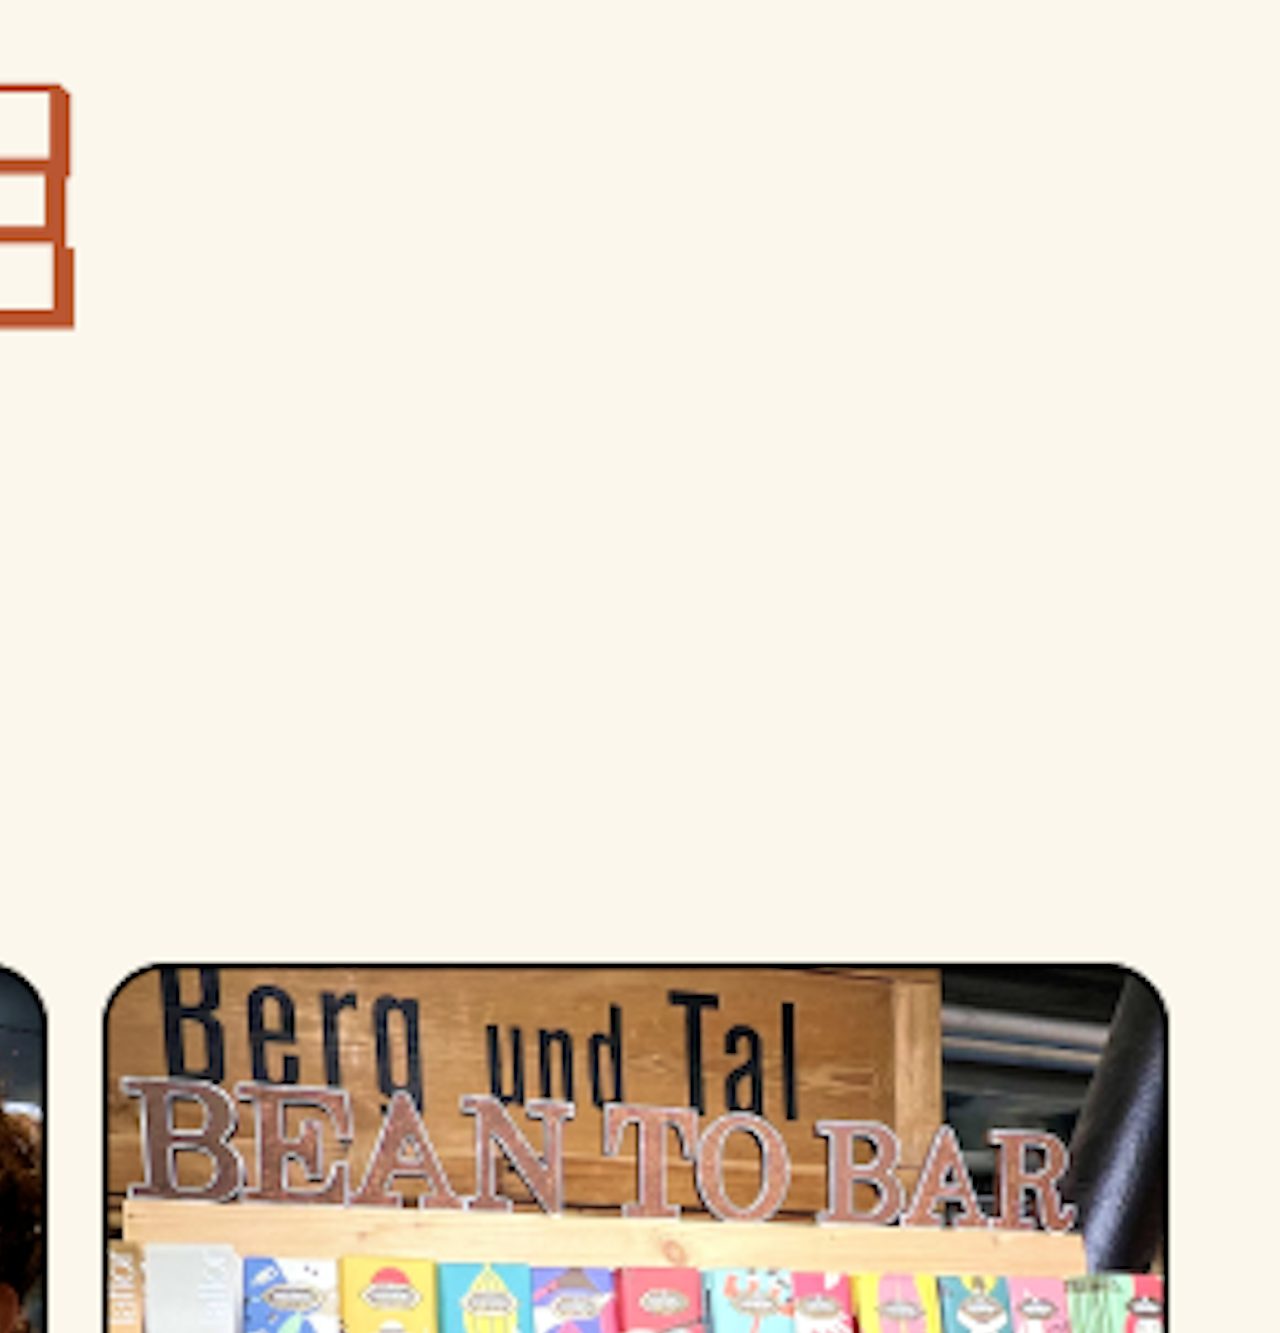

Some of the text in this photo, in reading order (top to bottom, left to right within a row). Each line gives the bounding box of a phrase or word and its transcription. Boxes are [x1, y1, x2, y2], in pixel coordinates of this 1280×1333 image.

[160, 968, 797, 1120] Berg und Tal
[121, 1075, 1079, 1232] BEAN TO BAR
